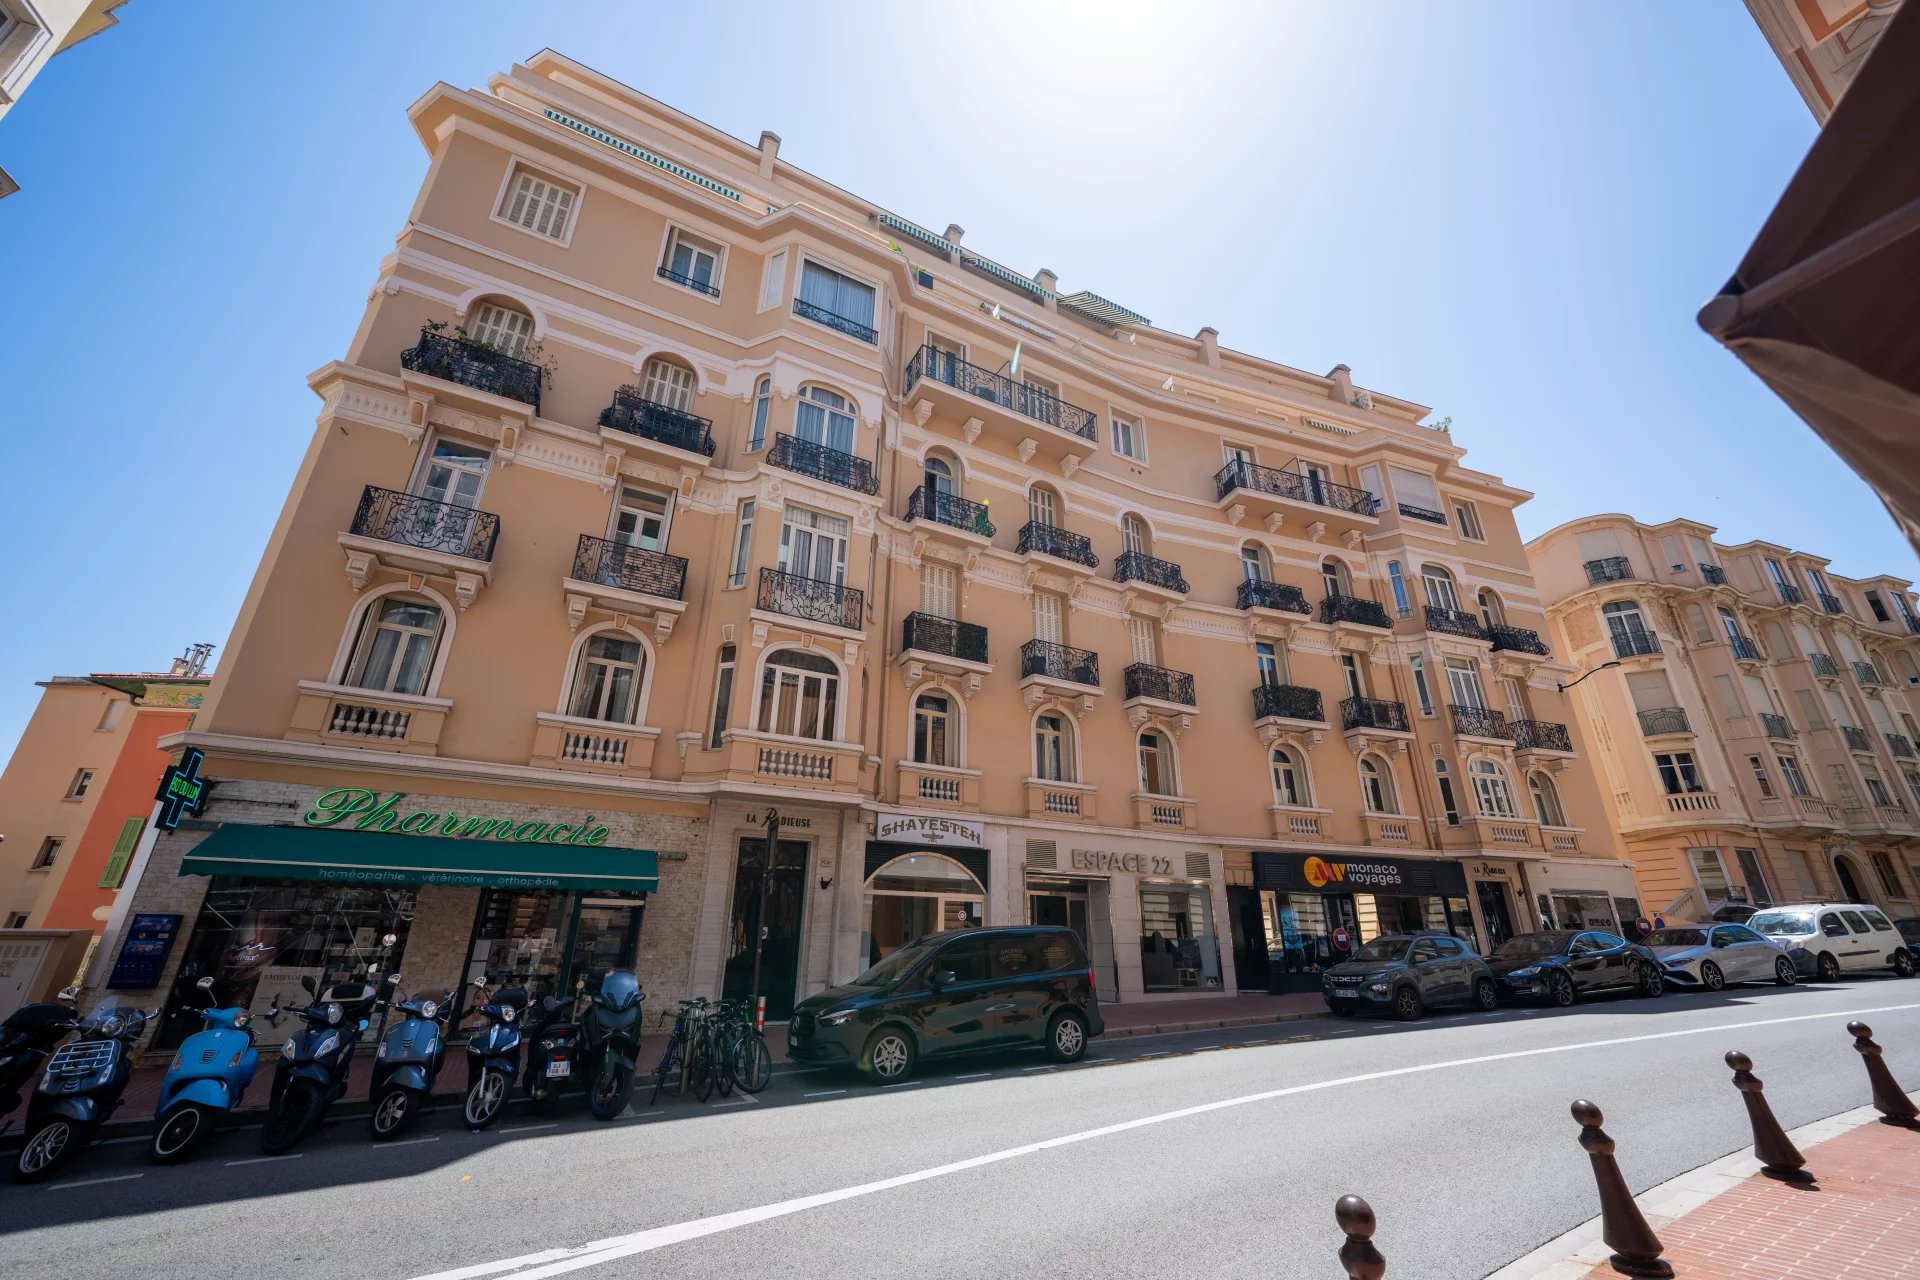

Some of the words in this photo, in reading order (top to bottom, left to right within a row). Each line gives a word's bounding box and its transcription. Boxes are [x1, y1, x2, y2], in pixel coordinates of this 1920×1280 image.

[304, 788, 610, 846] Pharmacie
[746, 813, 756, 823] LA
[761, 808, 812, 828] RDIEUSE
[881, 819, 981, 844] SHAYESTEH
[1072, 849, 1147, 873] ESPACE
[1151, 855, 1174, 875] 22
[1346, 863, 1397, 874] monaco
[318, 869, 406, 882] homéopathie
[422, 873, 484, 885] vétérinaire
[497, 876, 560, 887] orthopédie
[1348, 873, 1402, 886] voyages
